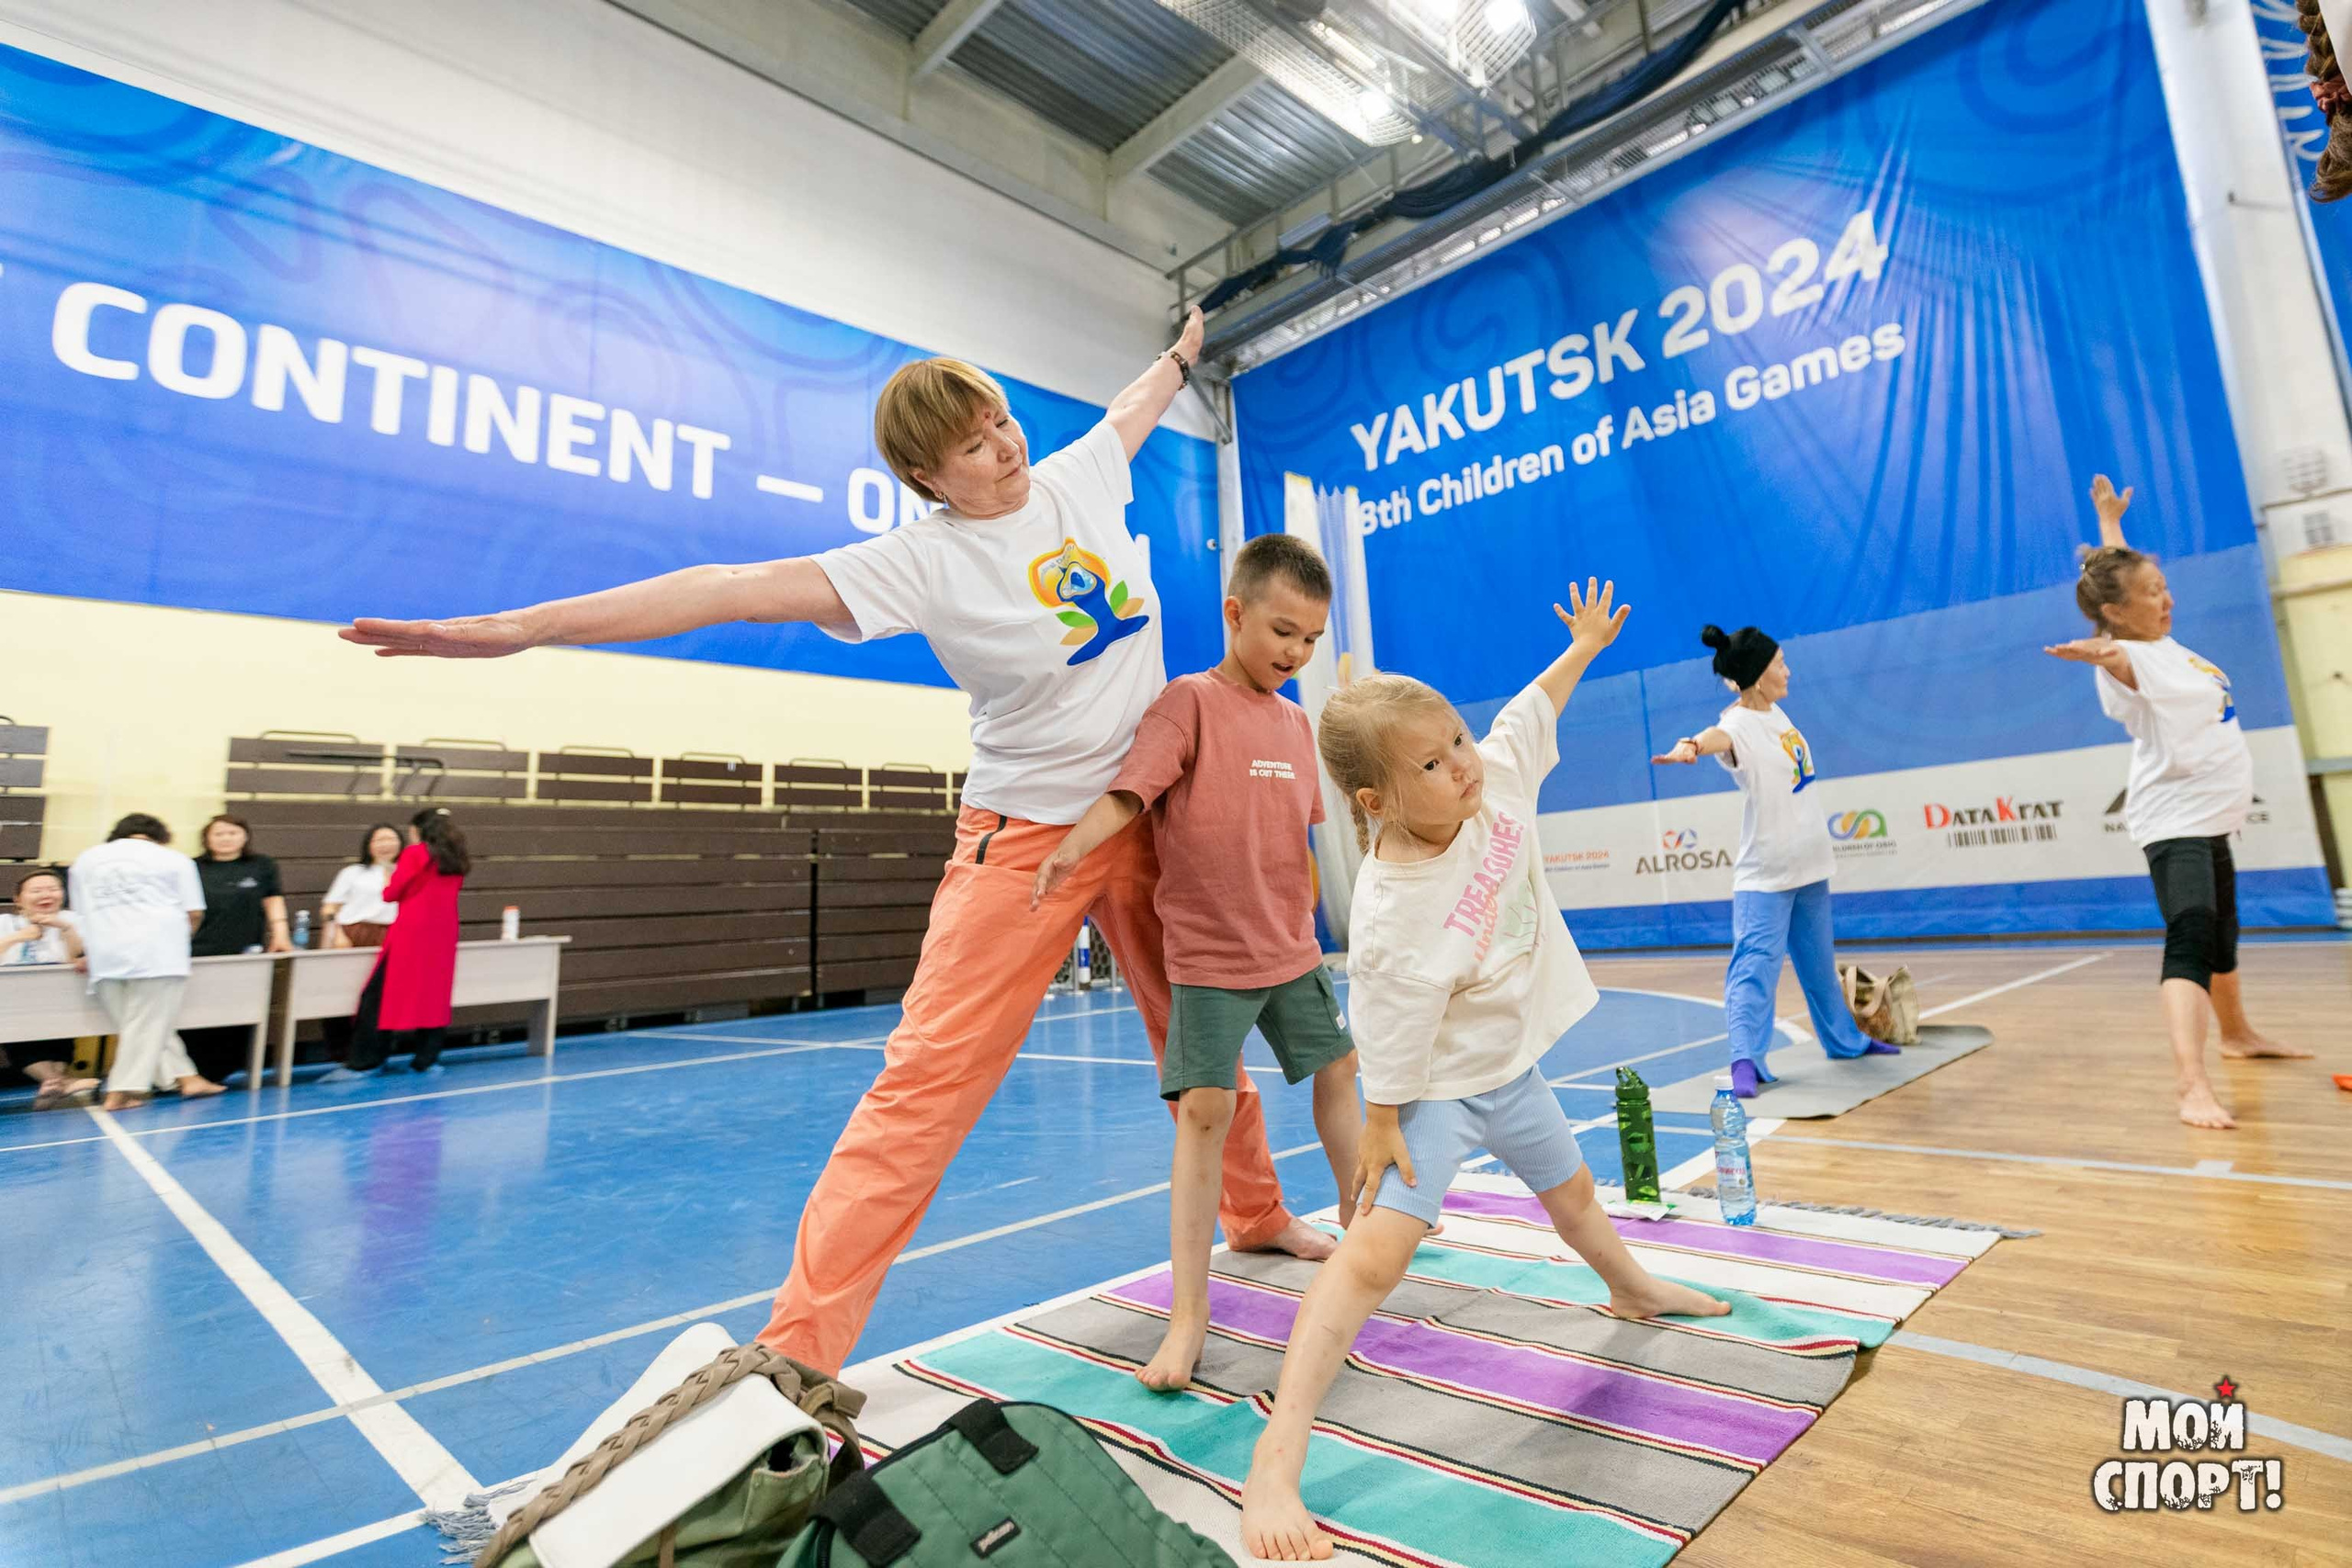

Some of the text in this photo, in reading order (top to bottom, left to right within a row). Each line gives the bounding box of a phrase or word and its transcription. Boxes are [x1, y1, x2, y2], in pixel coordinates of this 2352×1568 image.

[51, 281, 731, 500] CONTINENT
[1351, 210, 1887, 471] YAKUTSK 2024
[1418, 435, 1564, 516] Children
[1572, 422, 1614, 466] of
[1622, 389, 1715, 449] Asia
[1724, 323, 1905, 411] Games
[1635, 849, 1733, 874] ALROSA
